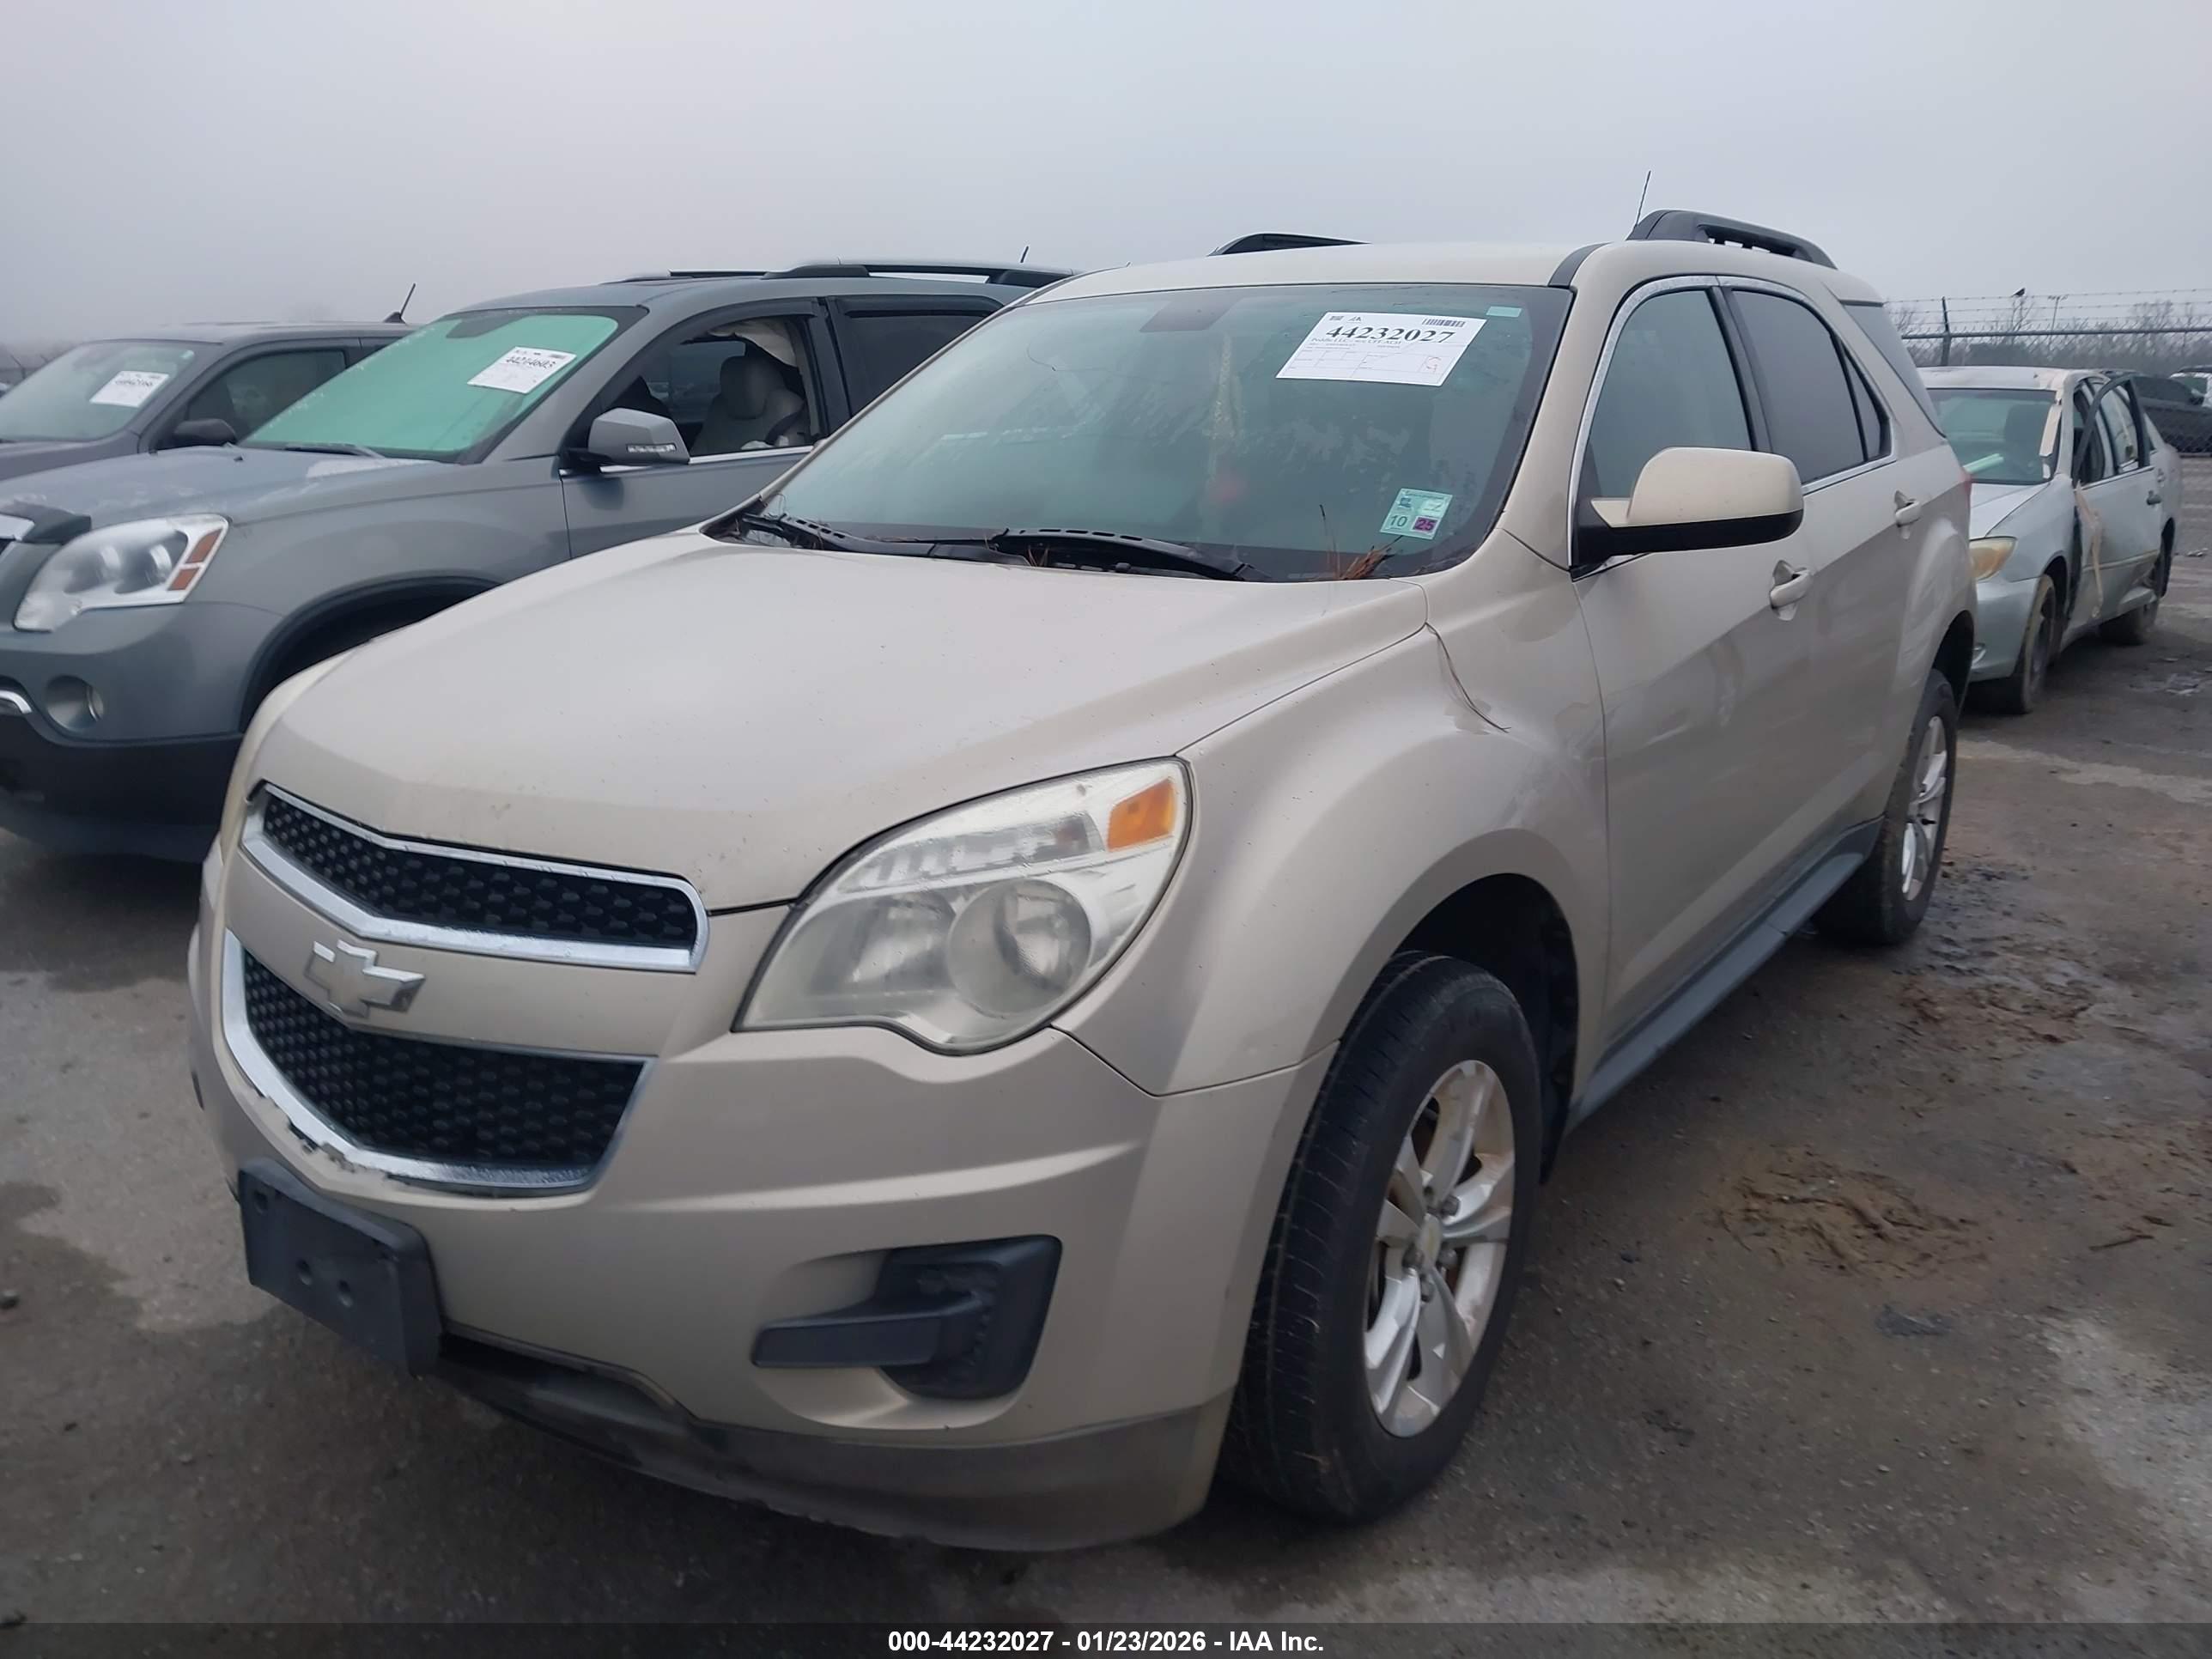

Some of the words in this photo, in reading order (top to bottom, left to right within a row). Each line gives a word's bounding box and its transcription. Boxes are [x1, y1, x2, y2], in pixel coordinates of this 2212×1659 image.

[1326, 325, 1455, 343] 44232027
[1390, 515, 1408, 527] 10
[1414, 519, 1435, 531] 25
